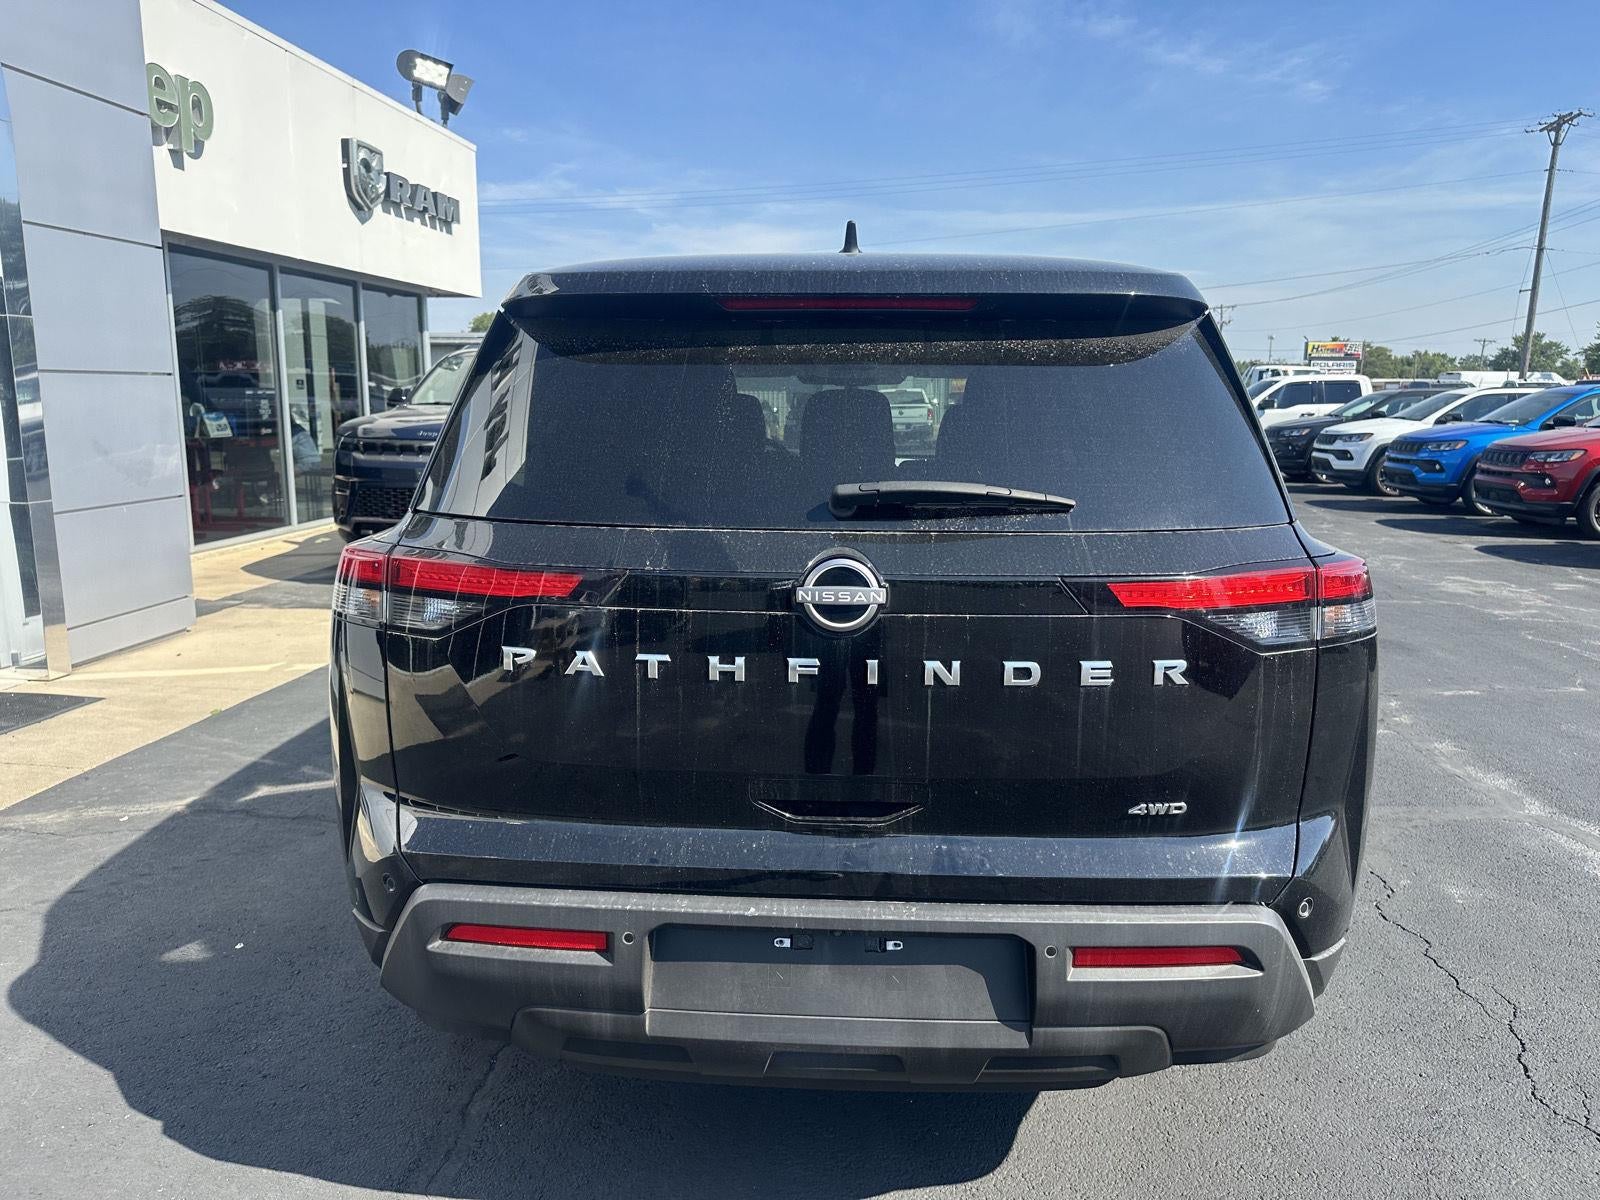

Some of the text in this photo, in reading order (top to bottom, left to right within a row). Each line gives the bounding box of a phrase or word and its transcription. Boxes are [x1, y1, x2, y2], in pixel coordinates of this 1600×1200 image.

[385, 172, 460, 224] RAM
[798, 590, 884, 602] NISSAN
[501, 645, 1190, 687] PATHFINDER
[1128, 801, 1188, 816] 4WD
